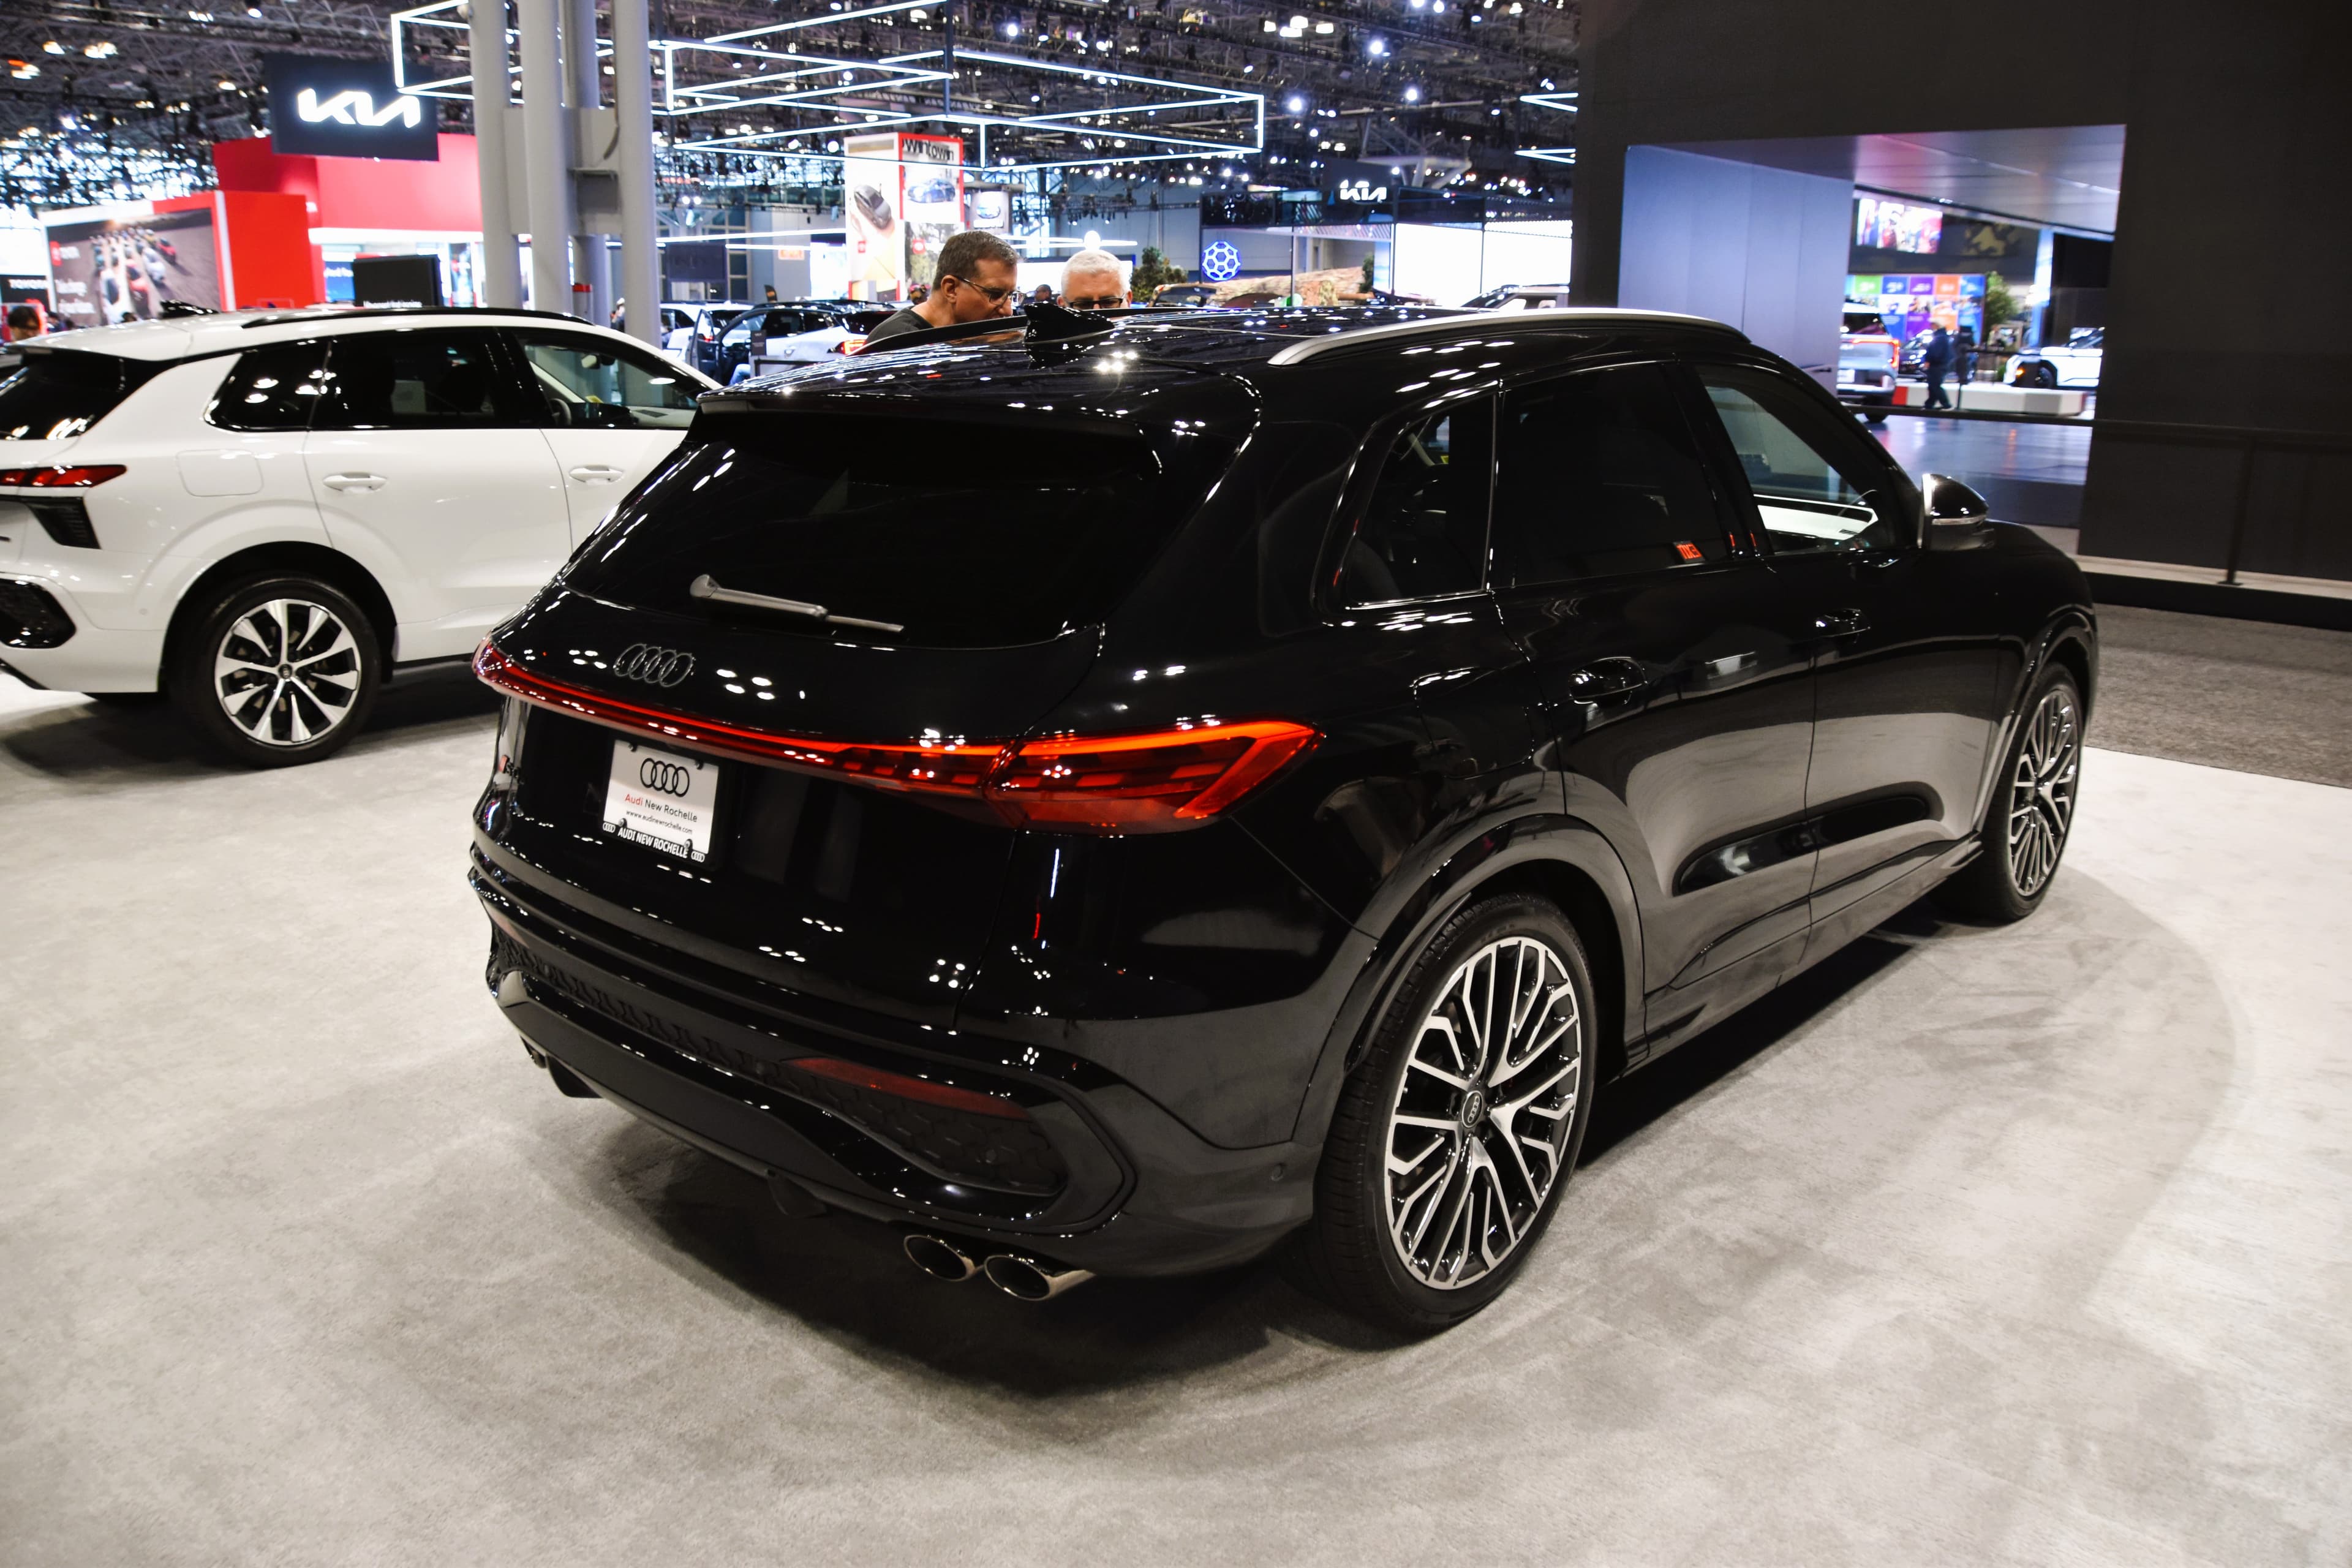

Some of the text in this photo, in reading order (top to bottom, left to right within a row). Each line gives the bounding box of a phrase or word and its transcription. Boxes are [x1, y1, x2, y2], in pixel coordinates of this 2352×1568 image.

[298, 88, 421, 129] KIA
[902, 138, 954, 161] wntown
[1340, 179, 1387, 203] KIA
[625, 794, 698, 823] Audi New Rochelle
[617, 827, 690, 859] AUDI NEW ROCHELLE
